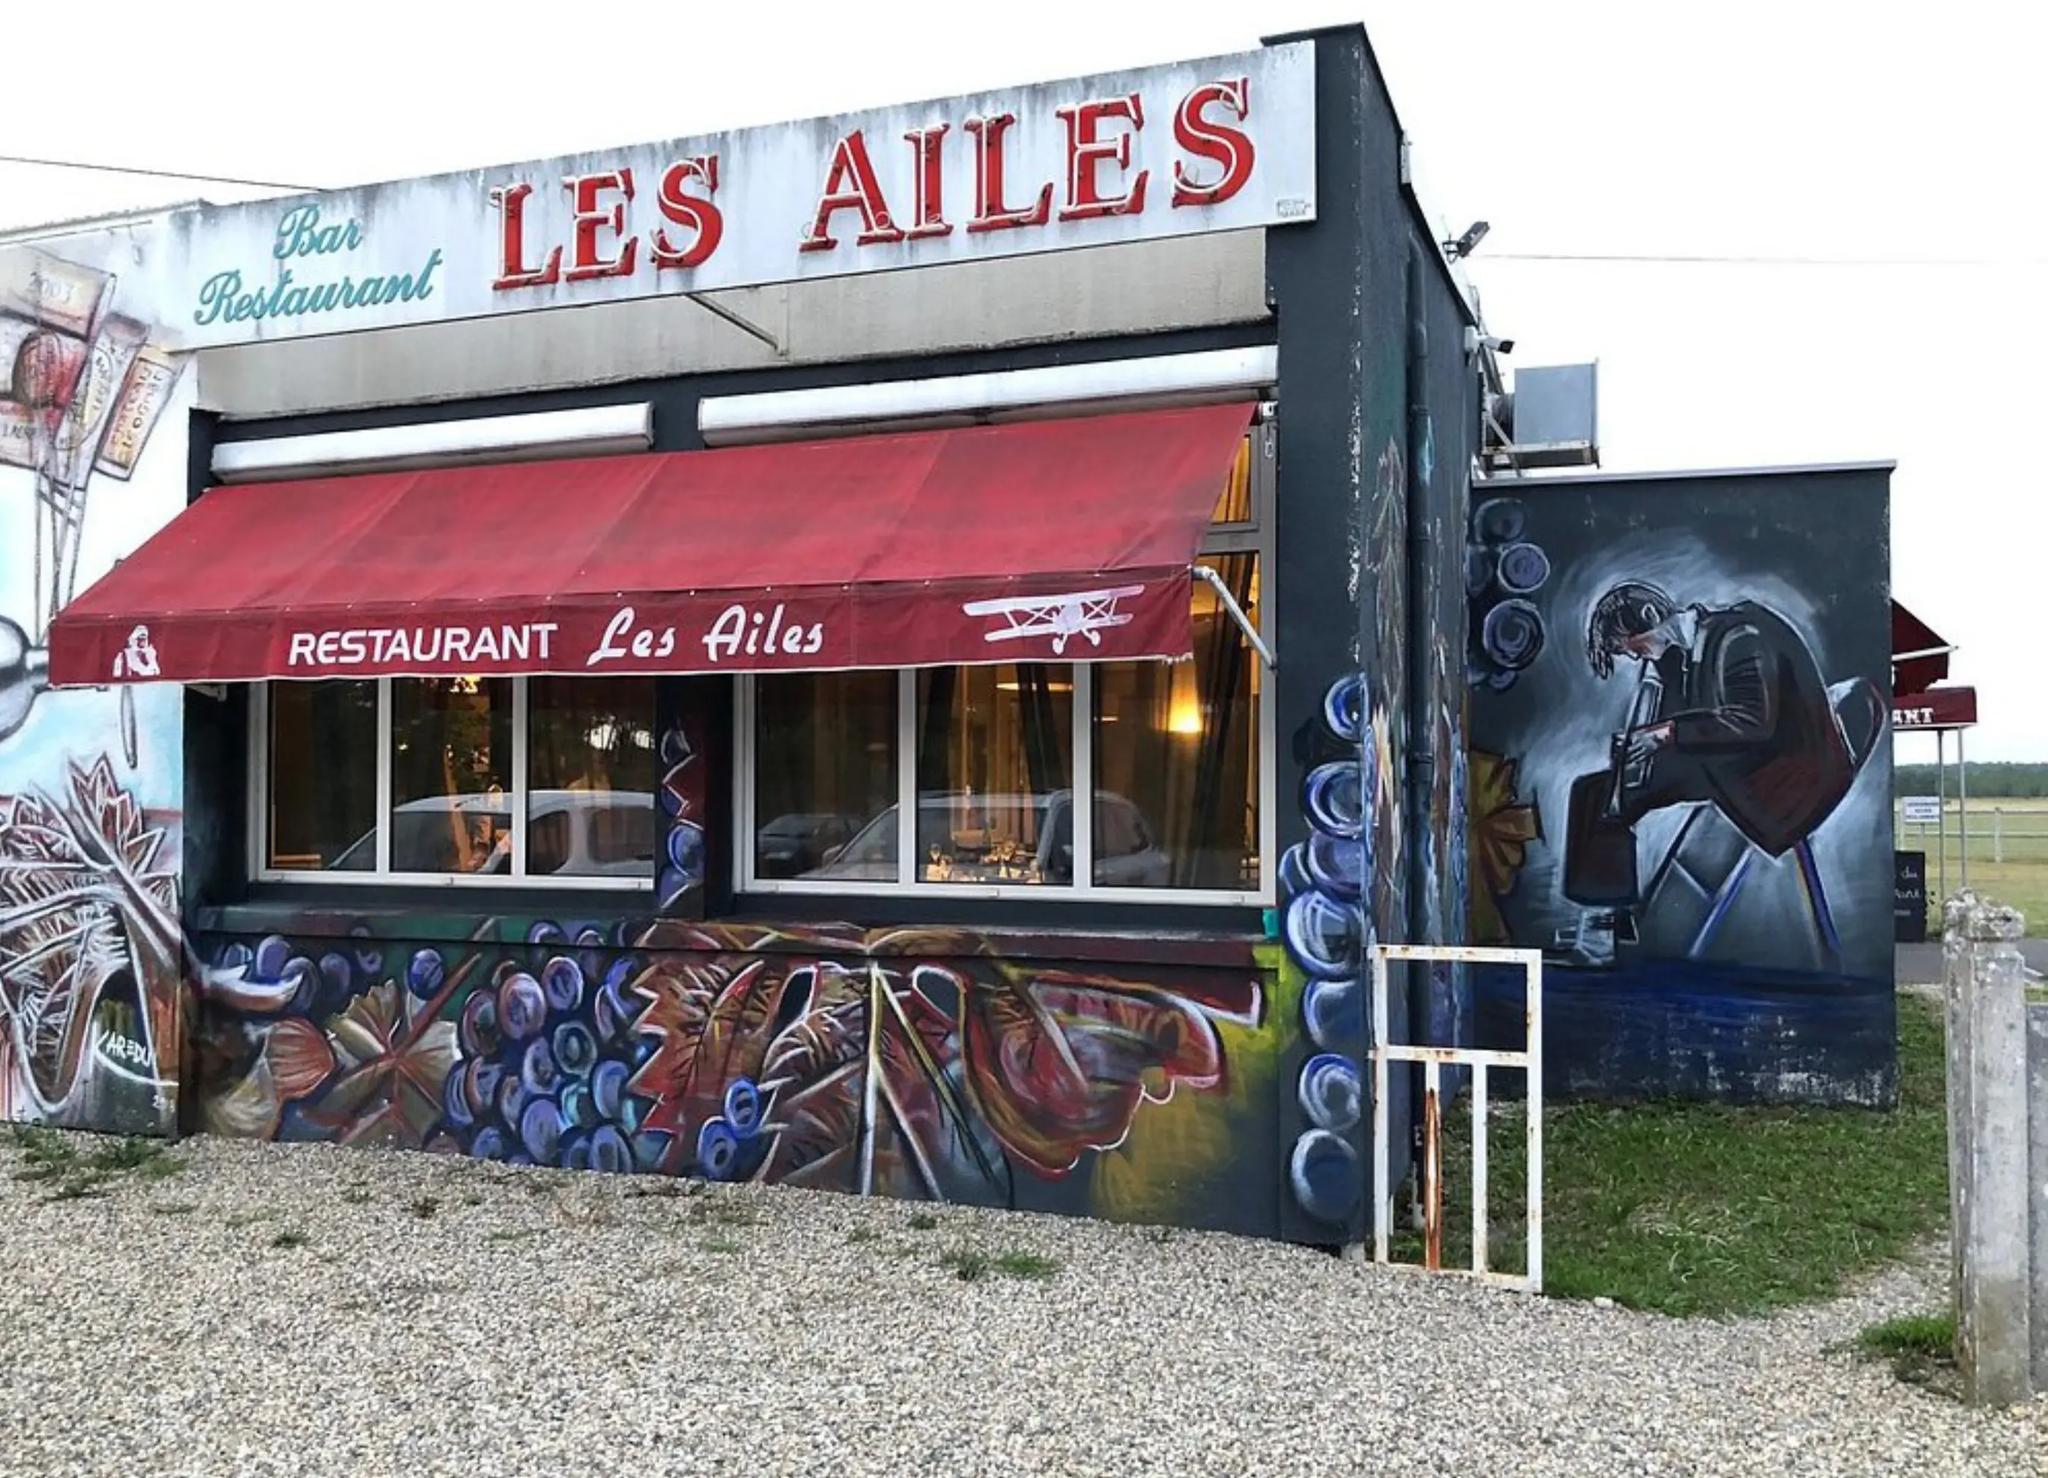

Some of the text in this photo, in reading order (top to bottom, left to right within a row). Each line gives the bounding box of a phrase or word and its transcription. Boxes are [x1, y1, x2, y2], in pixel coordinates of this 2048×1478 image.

[490, 77, 1256, 291] LES AILES
[272, 203, 363, 260] Bar
[194, 248, 443, 326] Restaurant
[288, 603, 824, 666] RESTAURANT Les Ailes
